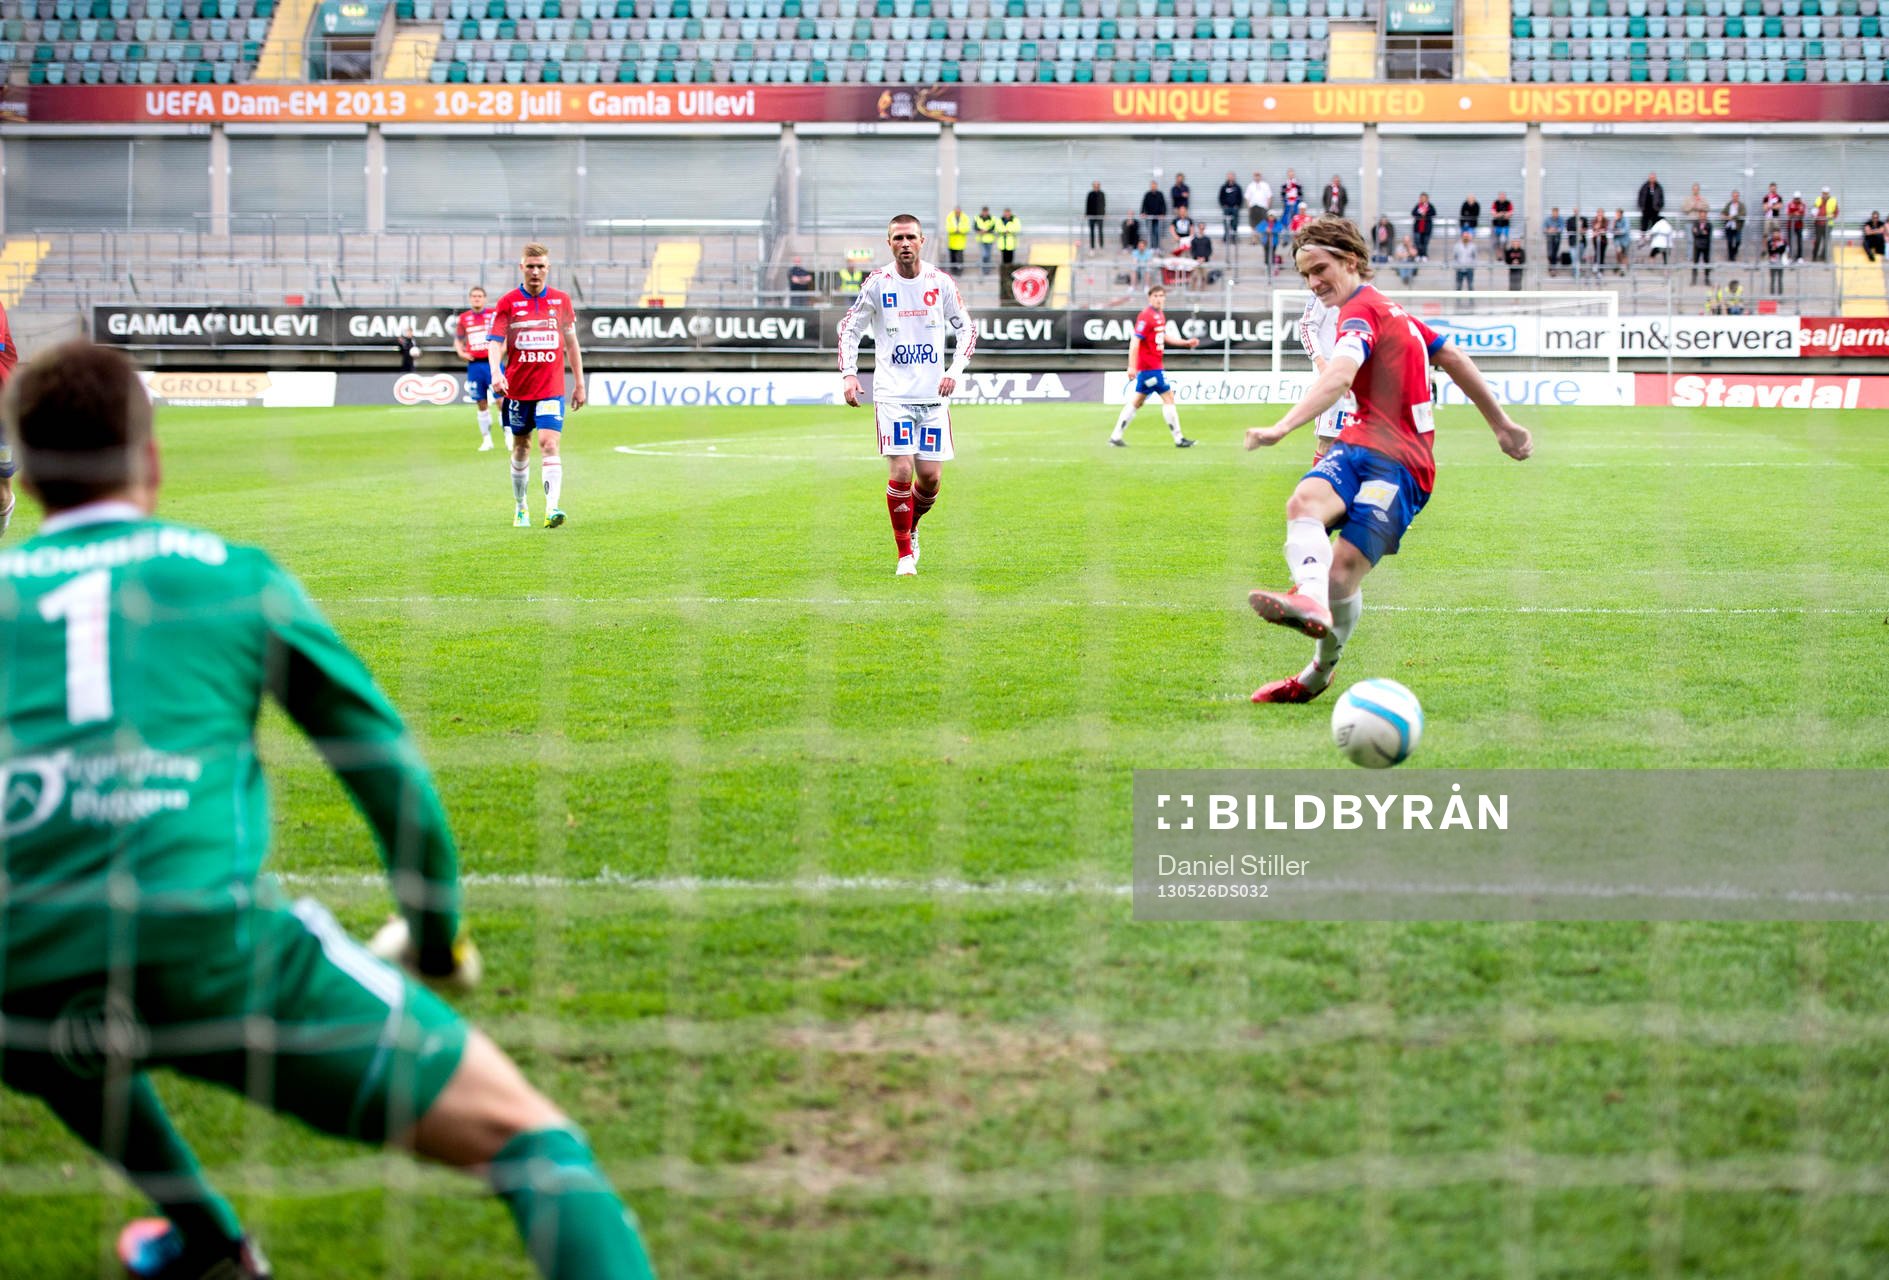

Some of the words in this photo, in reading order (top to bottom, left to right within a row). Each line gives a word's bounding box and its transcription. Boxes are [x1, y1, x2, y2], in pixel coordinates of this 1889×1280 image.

[145, 90, 216, 116] UEFA
[221, 91, 328, 116] Dam-EM
[335, 91, 407, 116] 2013
[433, 91, 514, 116] 10-28
[518, 91, 562, 120] juli
[587, 91, 671, 116] Gamla
[677, 91, 756, 116] Ullevi
[1112, 89, 1230, 121] UNIQUE
[1312, 89, 1425, 116] UNITED
[1508, 88, 1731, 116] UNSTOPPABLE
[107, 313, 203, 336] GAMLA
[228, 314, 319, 337] ULLEVI
[349, 315, 445, 338] GAMLA
[591, 316, 688, 339] GAMLA
[715, 317, 805, 340] ULLEVI
[974, 318, 1053, 341] LLEVI
[1546, 321, 1792, 350] marin&servera
[895, 344, 934, 355] OUTO
[1449, 333, 1507, 347] HUS
[518, 351, 556, 362] ÅBRO
[892, 353, 938, 365] KUMPU
[161, 378, 257, 393] GROLLS
[604, 380, 776, 405] Volvokort
[1671, 376, 1861, 408] Stavdal
[38, 567, 112, 726] 1
